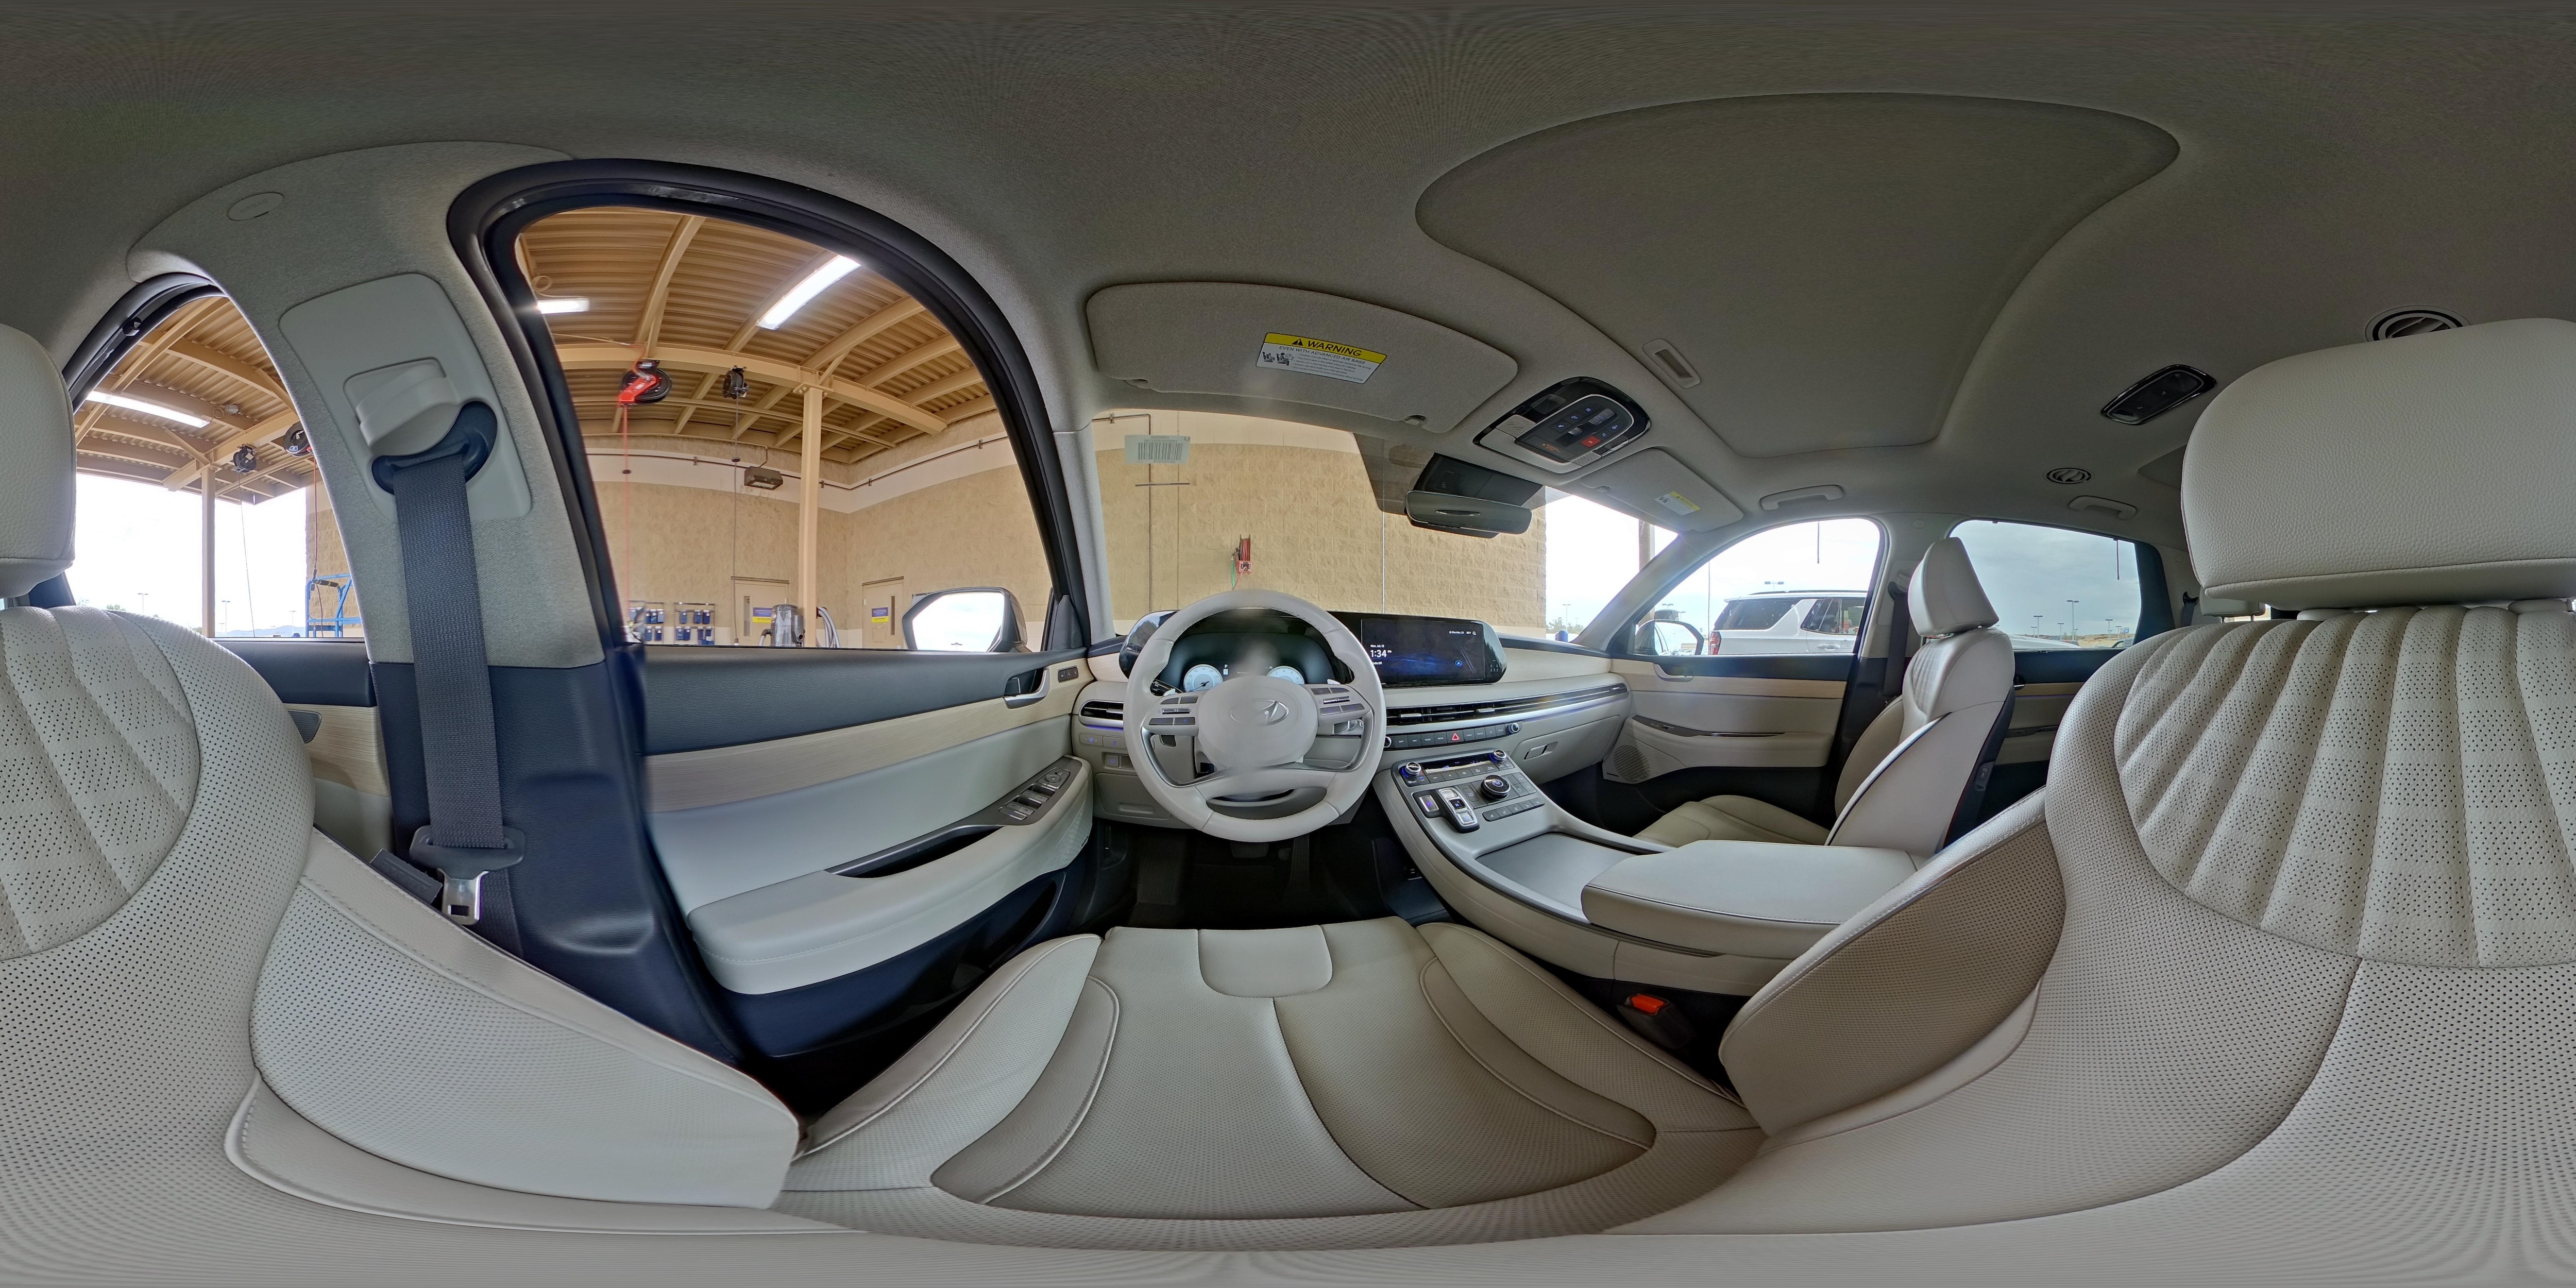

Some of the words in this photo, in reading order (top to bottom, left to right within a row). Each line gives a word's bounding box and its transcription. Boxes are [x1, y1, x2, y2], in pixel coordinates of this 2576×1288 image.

[1308, 340, 1362, 357] WARNING
[1310, 351, 1341, 359] ADVANCED
[1370, 649, 1387, 657] 1:34
